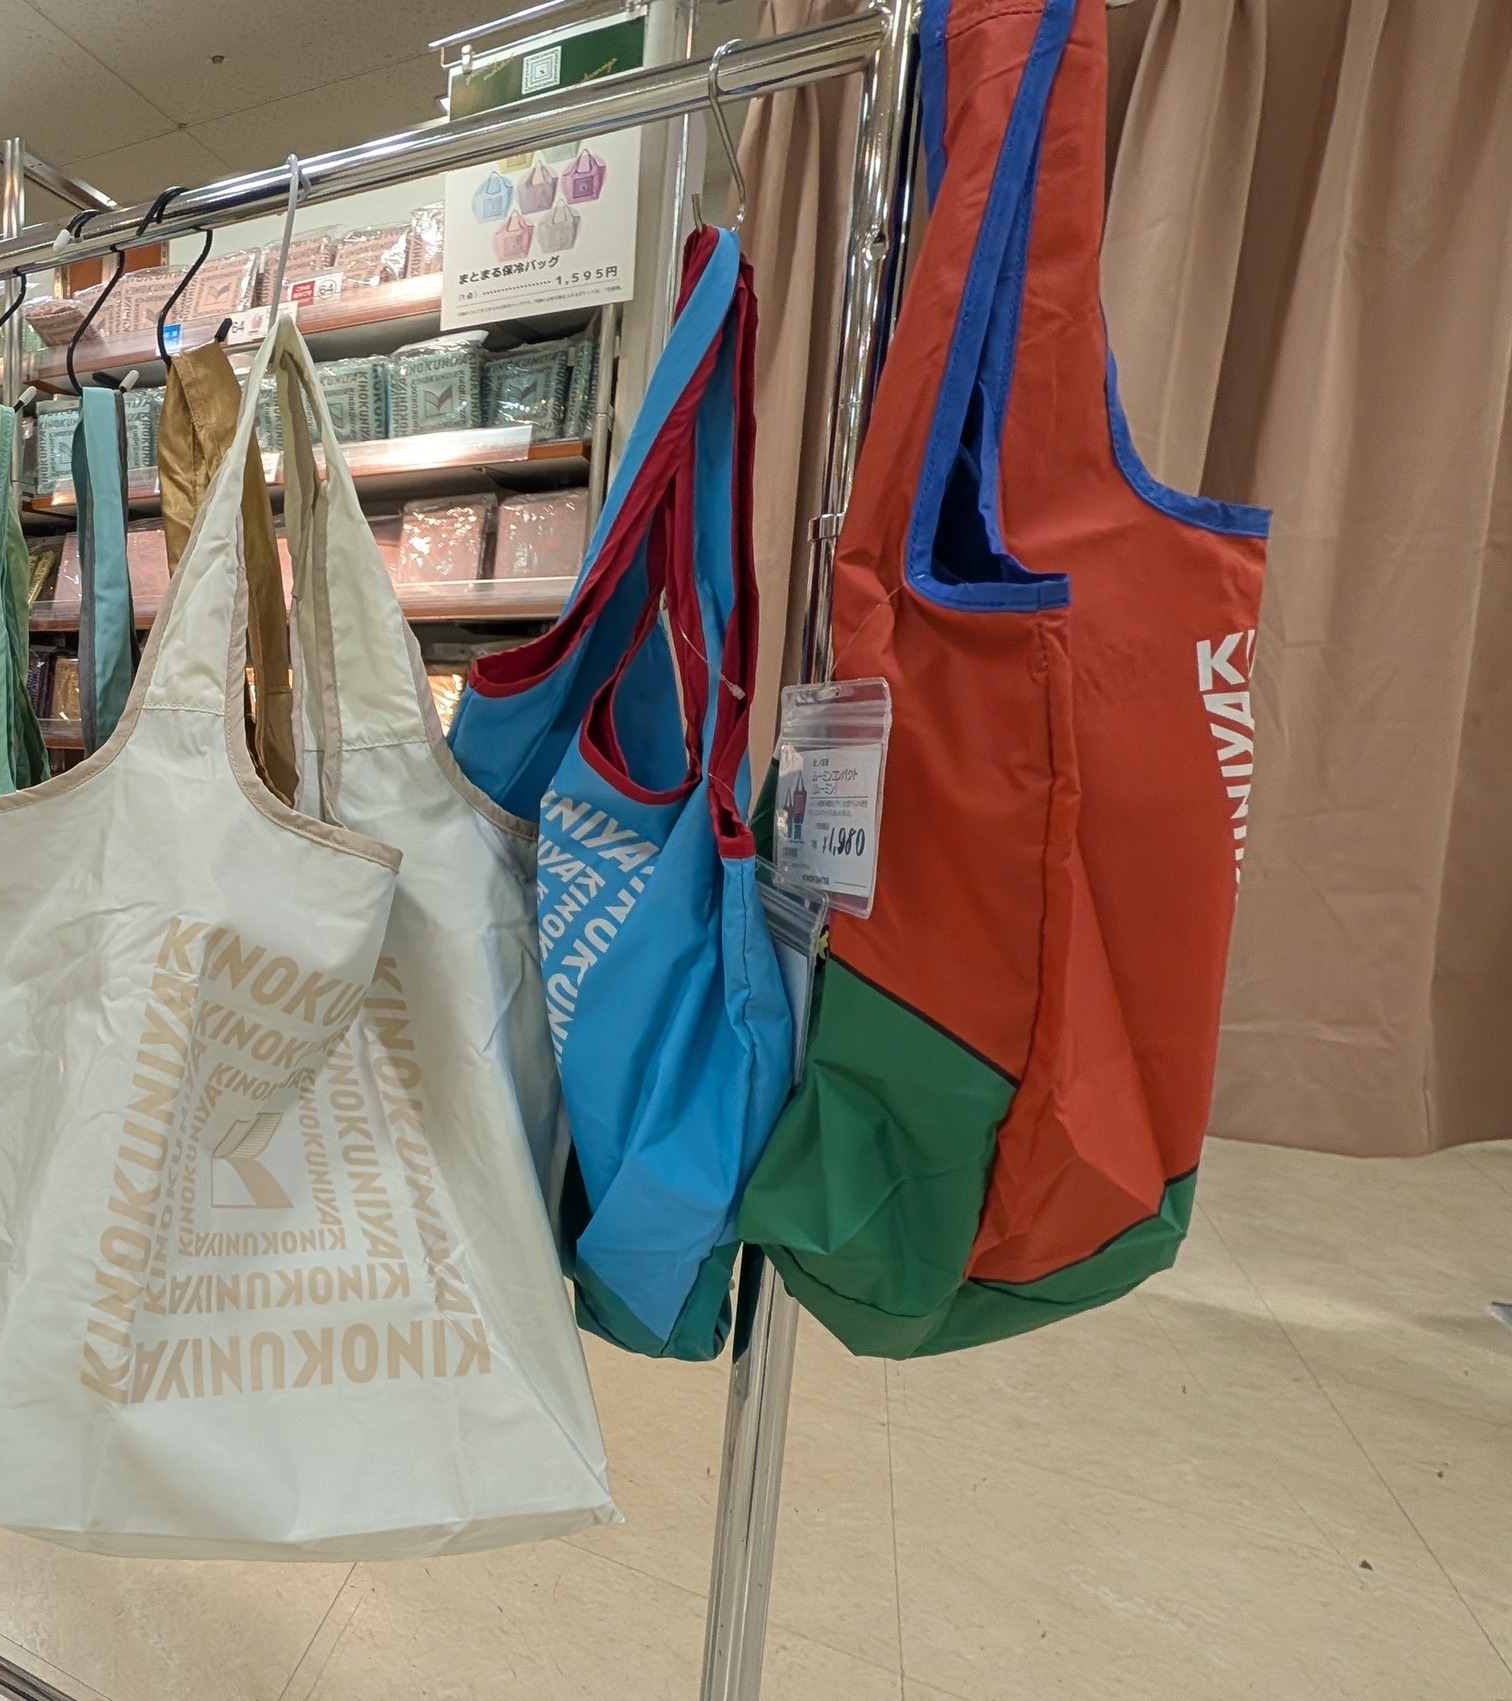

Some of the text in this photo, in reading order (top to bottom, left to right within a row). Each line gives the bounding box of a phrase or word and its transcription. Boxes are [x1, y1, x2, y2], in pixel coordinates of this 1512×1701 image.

[458, 254, 560, 285] まとまる保冷バッグ
[556, 265, 619, 286] 1,595円
[822, 827, 866, 857] ¥1,980
[80, 972, 199, 1407] KINOKUNIYA
[178, 1081, 224, 1257] KINOKUNIYA
[193, 1227, 347, 1257] KINOKUNIYA
[166, 1262, 411, 1315] KINOKUNIYA
[128, 1316, 492, 1405] KINOKUNIYA
